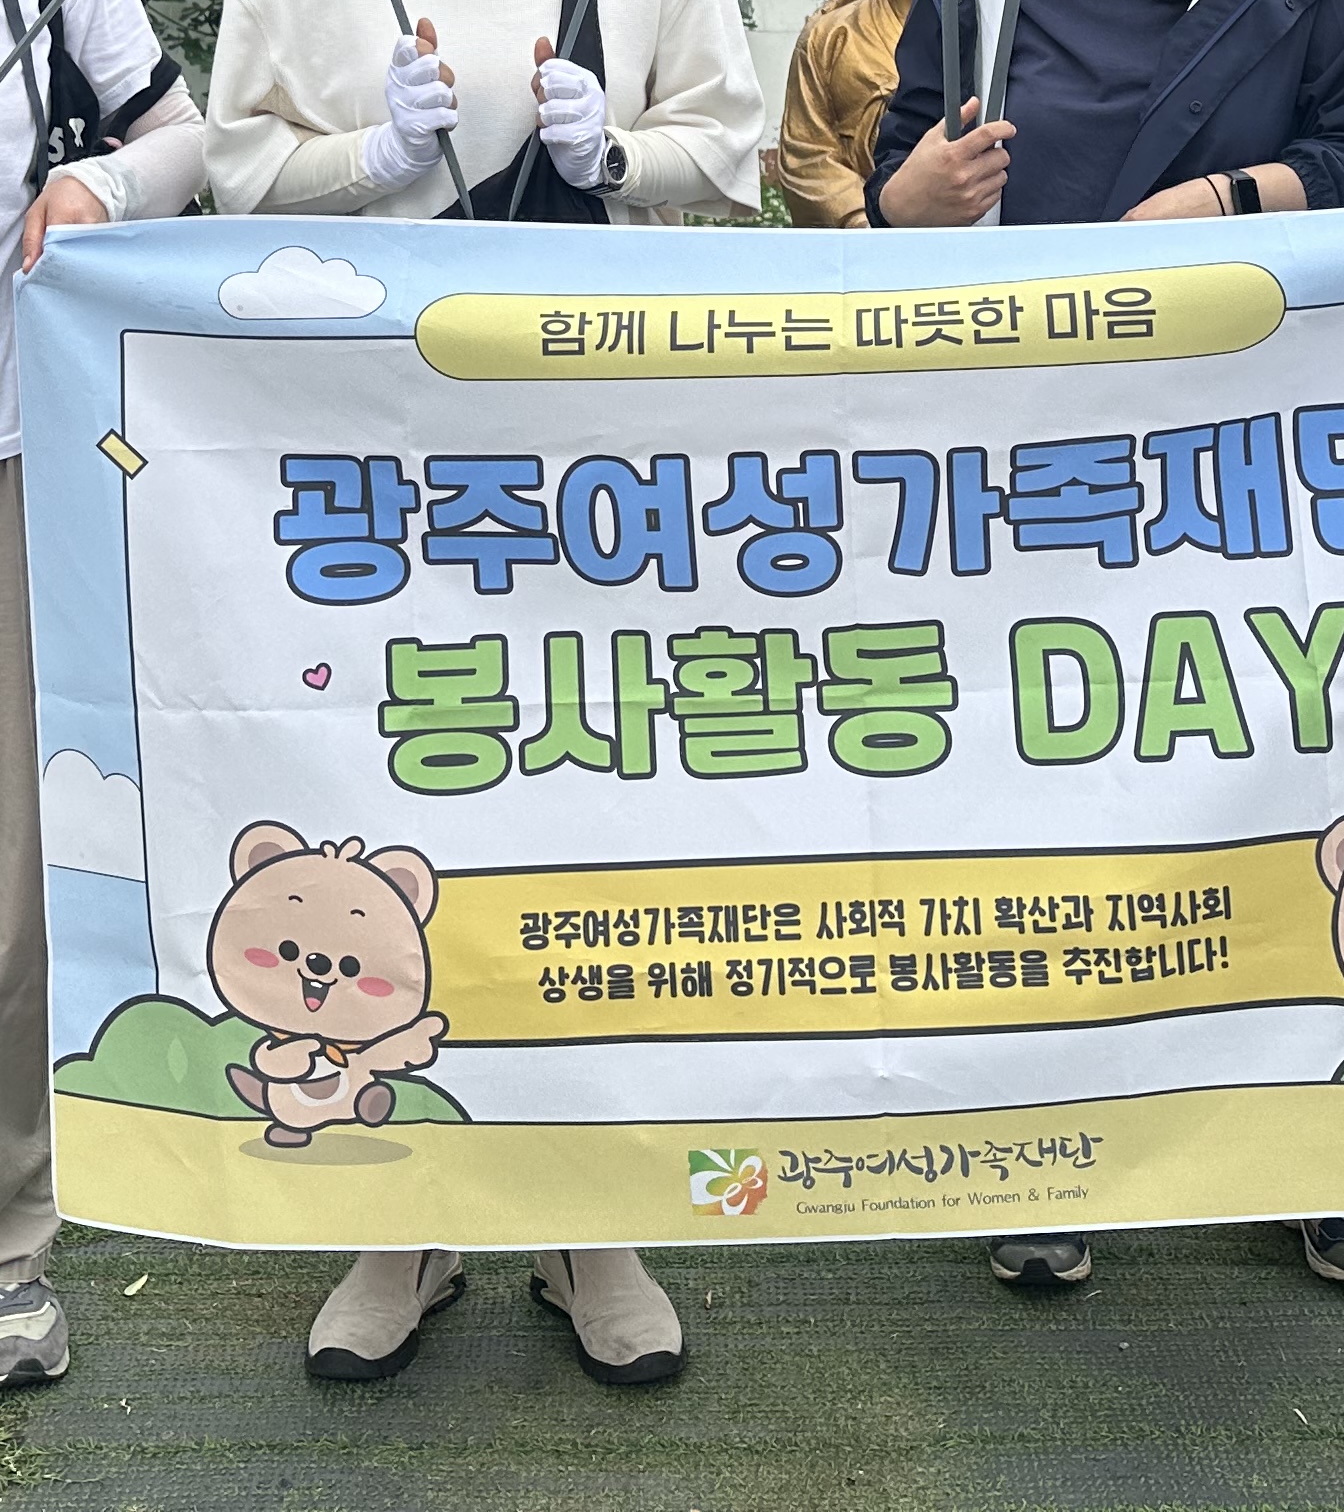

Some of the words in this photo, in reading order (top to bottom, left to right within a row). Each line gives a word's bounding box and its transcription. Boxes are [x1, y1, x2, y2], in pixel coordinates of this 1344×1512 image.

[540, 310, 645, 357] 함께
[670, 307, 833, 355] 나누는
[856, 295, 1023, 349] 따뜻한
[1046, 287, 1157, 341] 마음
[378, 620, 959, 796] 봉사활동
[519, 903, 802, 951] 광주여성가족재단은
[816, 899, 906, 940] 사회적
[919, 895, 982, 937] 가치
[994, 895, 1094, 935] 확산과
[1105, 885, 1232, 931] 지역사회
[538, 964, 635, 1004] 상생을
[647, 960, 713, 999] 위해
[726, 954, 877, 997] 정기적으로
[889, 949, 1049, 992] 봉사활동을
[1062, 935, 1229, 986] 추진합니다!
[777, 1131, 1104, 1189] 광주여성가족재단
[796, 1201, 856, 1215] Gwangju
[861, 1197, 936, 1212] Foundation
[941, 1195, 961, 1207] for
[967, 1191, 1021, 1206] Women
[1027, 1188, 1040, 1202] &
[1047, 1184, 1089, 1201] Family
